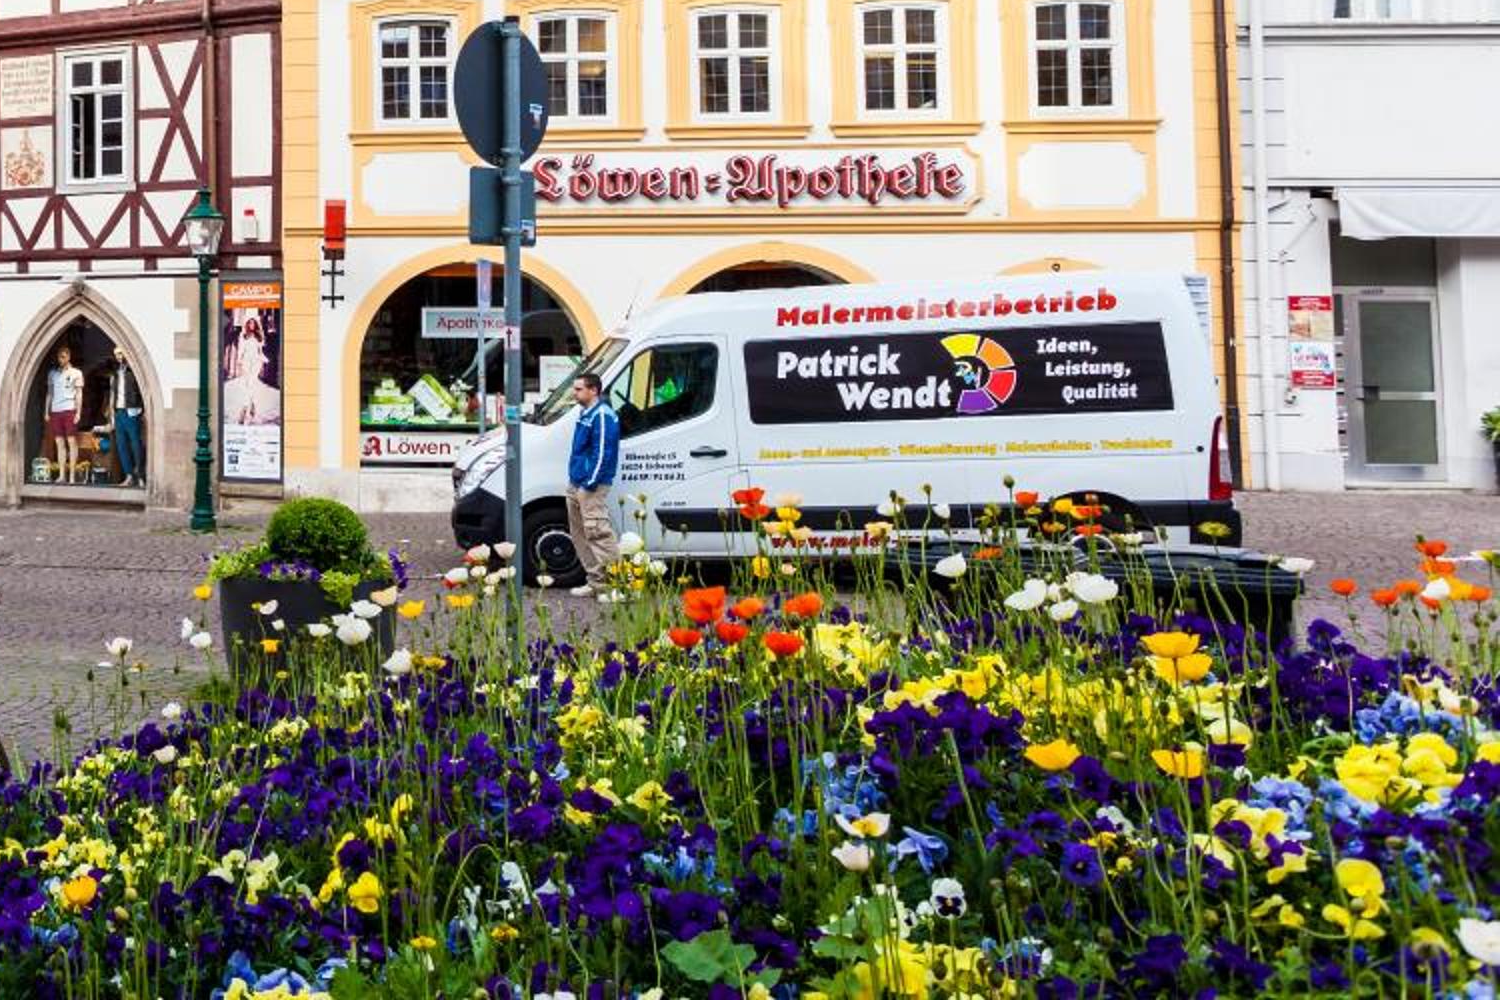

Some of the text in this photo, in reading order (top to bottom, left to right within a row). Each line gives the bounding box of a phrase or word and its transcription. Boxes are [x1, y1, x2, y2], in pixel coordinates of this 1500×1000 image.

[776, 287, 1117, 327] Malermeisterbetrieb
[1036, 337, 1098, 355] Ideen,
[777, 343, 901, 380] Patrick
[1045, 359, 1132, 379] Leistung,
[836, 376, 953, 412] Wendt
[1061, 382, 1139, 405] Qualität
[387, 438, 451, 455] Löwen
